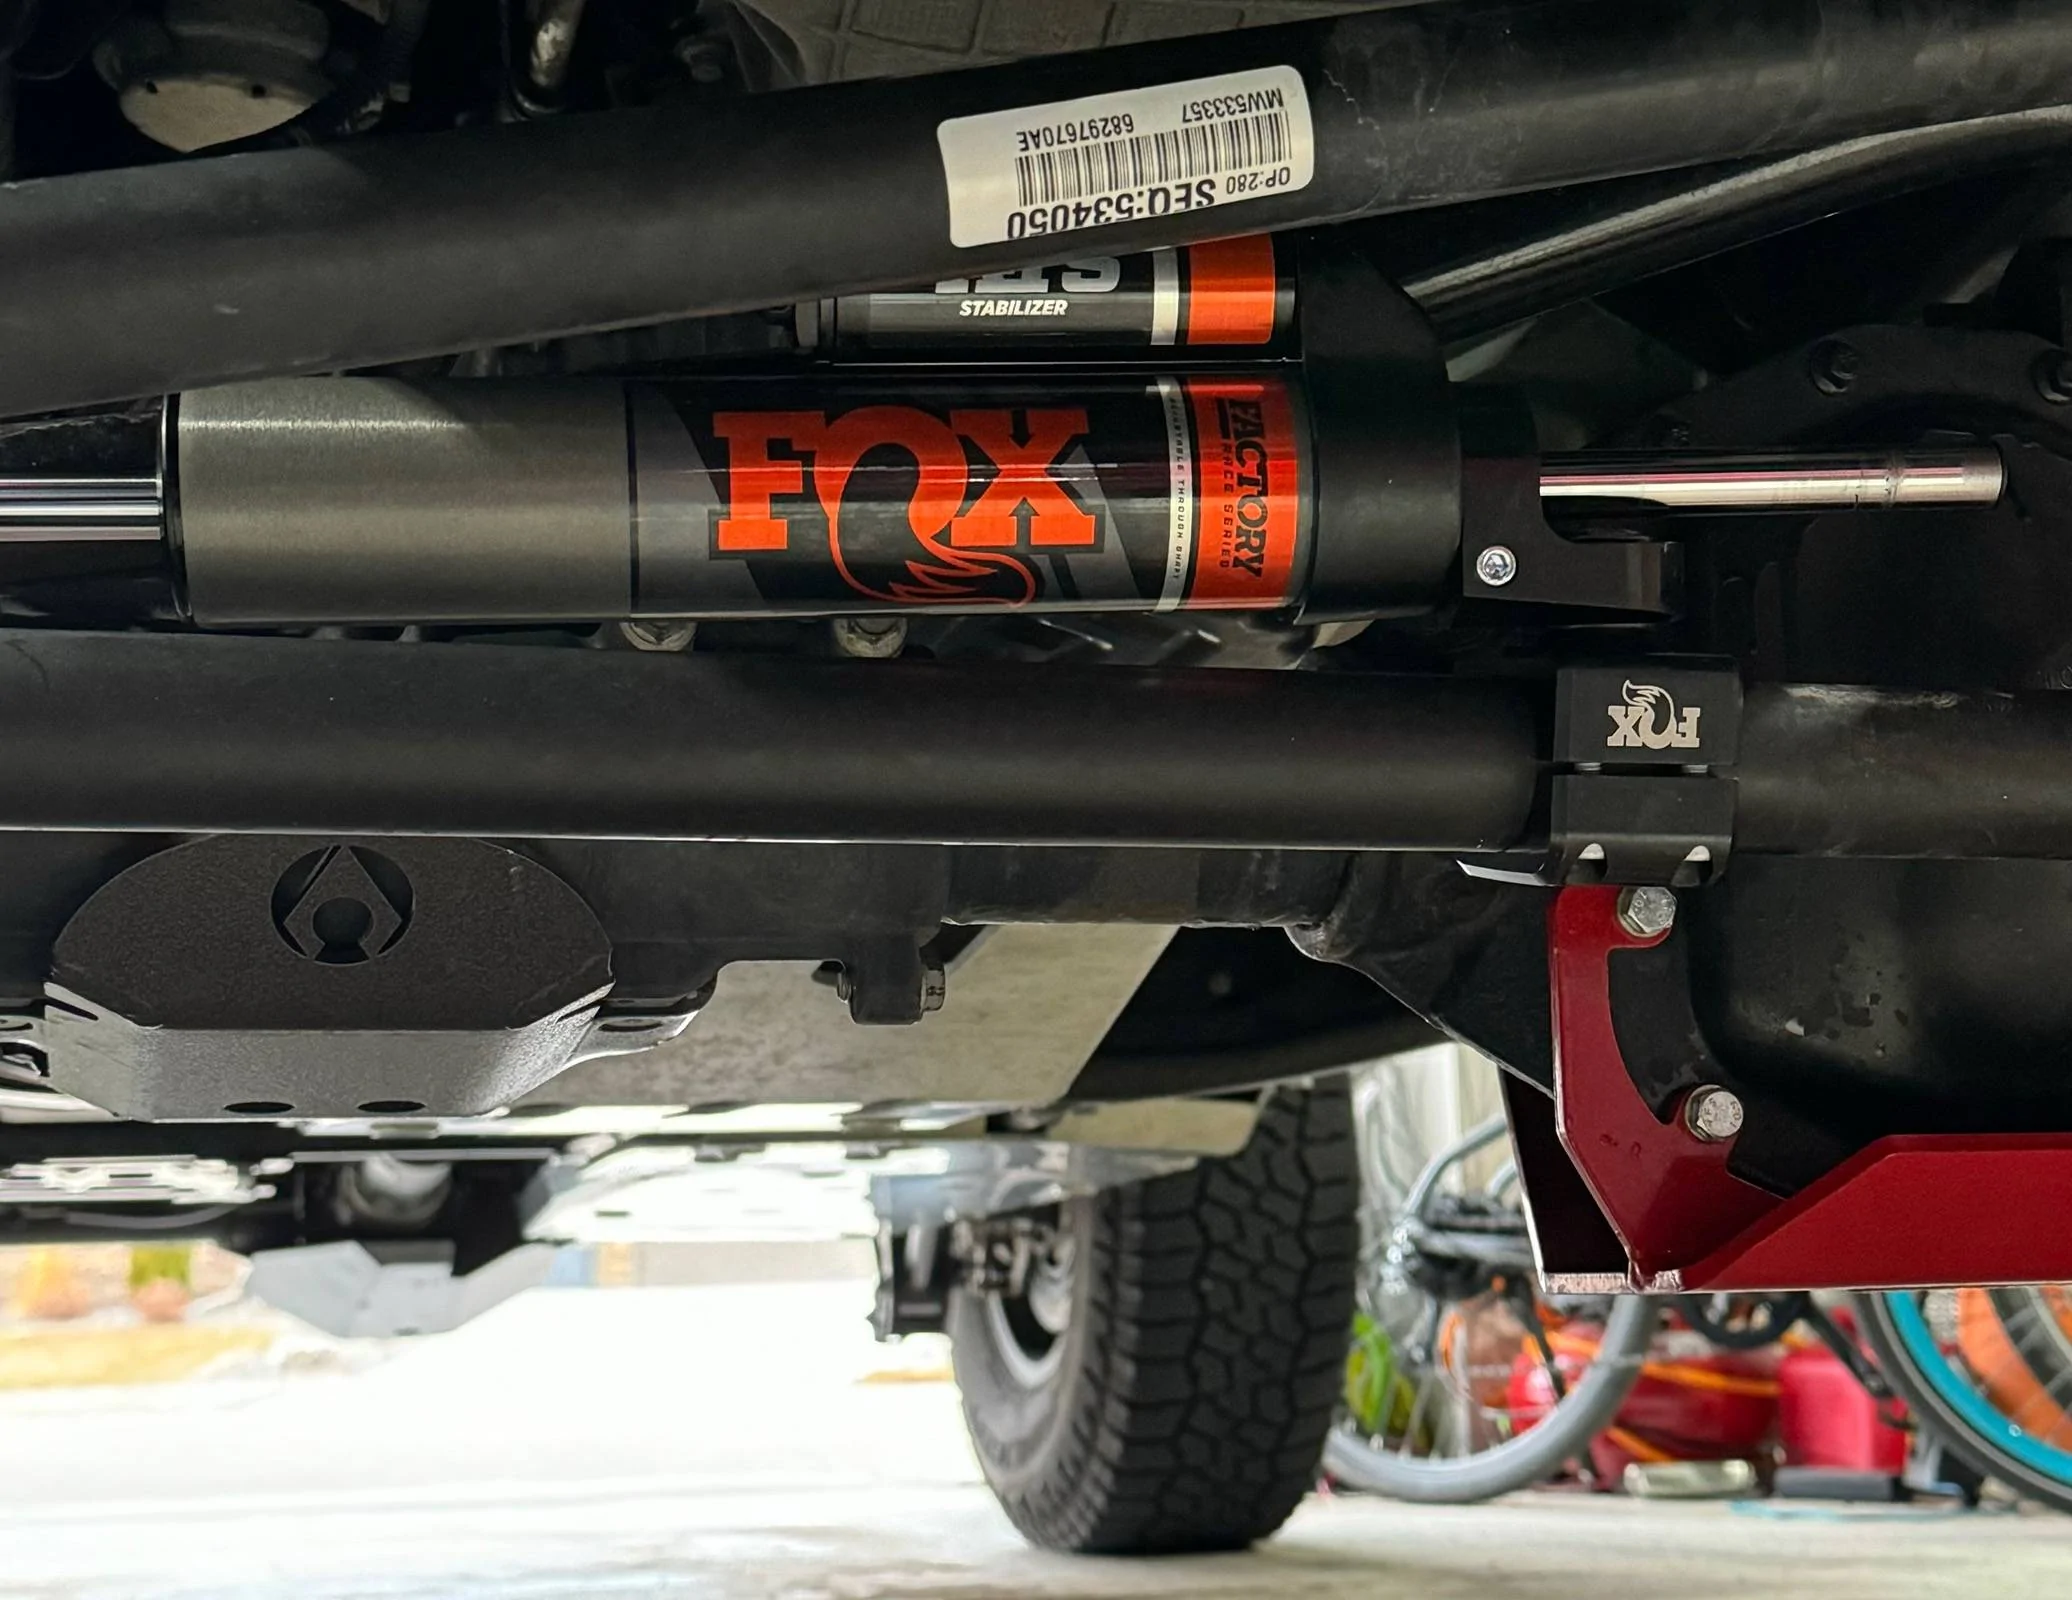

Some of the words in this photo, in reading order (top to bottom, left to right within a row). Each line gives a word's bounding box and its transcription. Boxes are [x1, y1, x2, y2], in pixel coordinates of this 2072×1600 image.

[1015, 112, 1135, 151] 68297670AE
[1181, 87, 1284, 123] MW533357
[1006, 178, 1217, 240] SEQ:534050
[1226, 166, 1291, 195] OP:280
[959, 298, 1069, 317] STABILIZER
[1220, 442, 1234, 494] RACE
[1228, 398, 1269, 578] FACTORY
[712, 405, 1098, 606] FOX
[1176, 479, 1185, 539] THROUGH
[1219, 504, 1234, 569] SERIES
[1606, 679, 1701, 750] FOX
